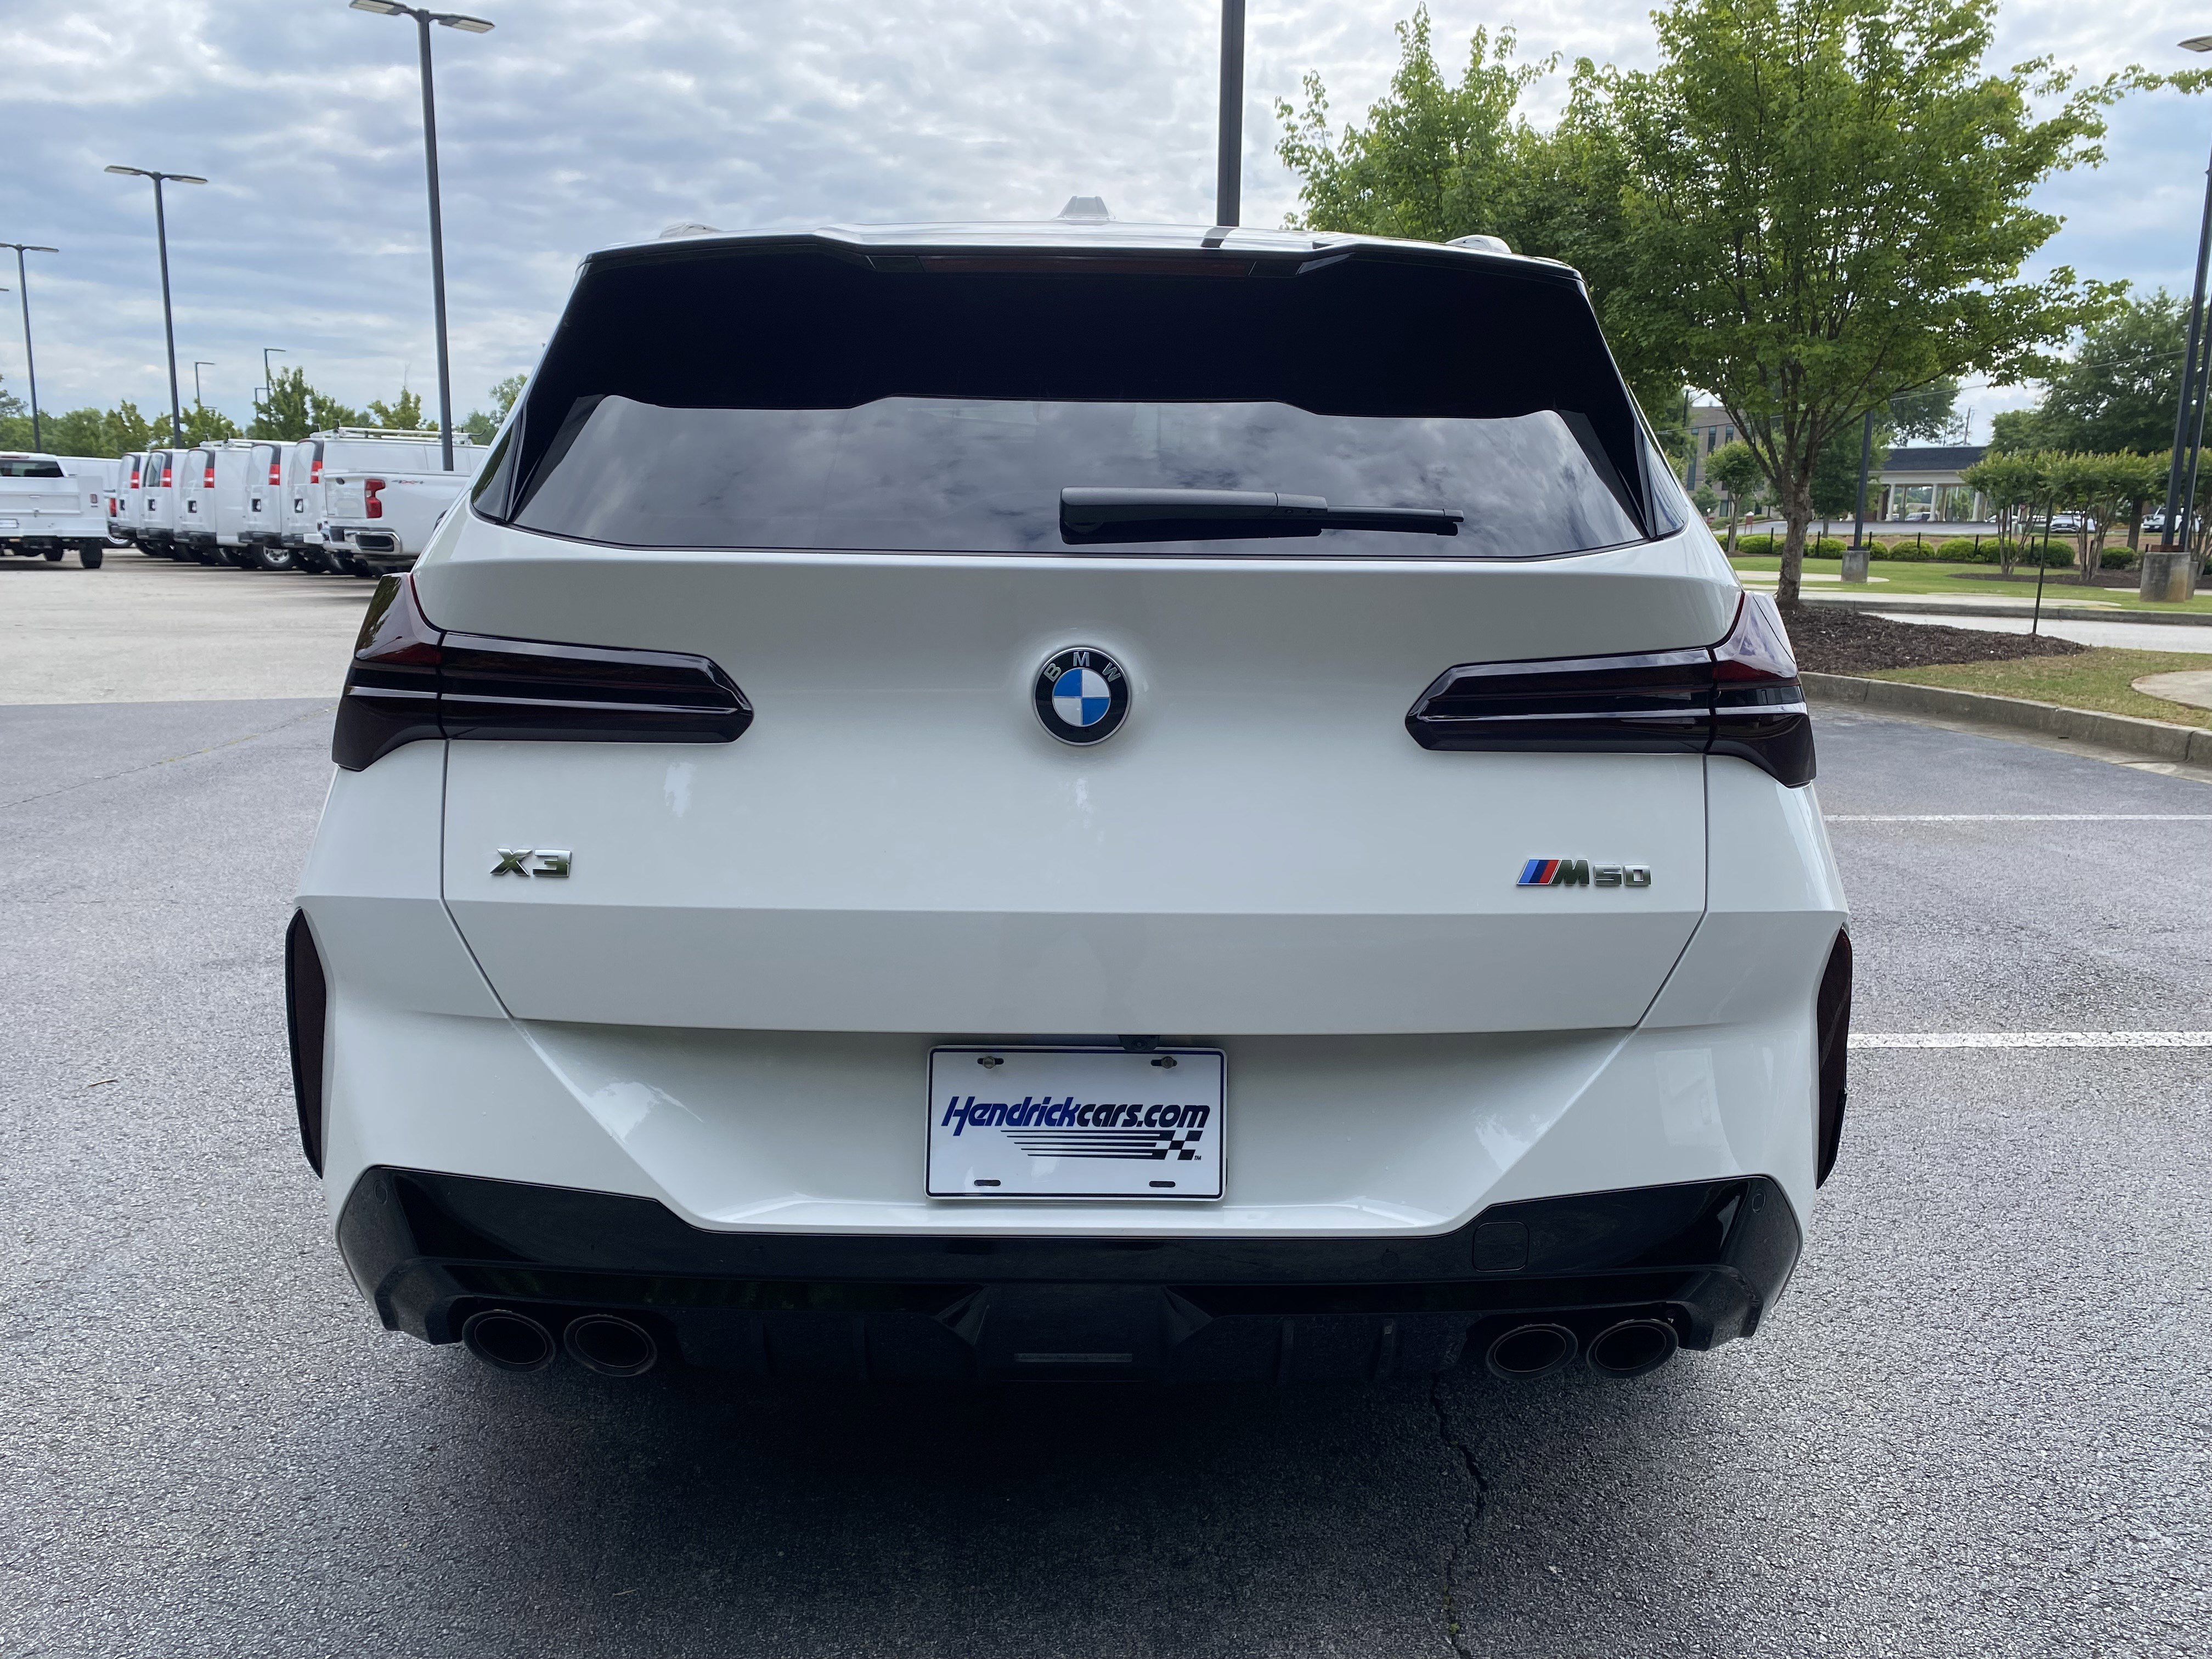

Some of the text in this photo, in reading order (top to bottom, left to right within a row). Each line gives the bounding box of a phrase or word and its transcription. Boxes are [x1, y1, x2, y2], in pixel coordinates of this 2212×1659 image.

[1043, 651, 1121, 682] BMW
[490, 848, 571, 877] X3
[1548, 859, 1651, 885] M50
[941, 1096, 1210, 1136] Hendrickcars.com
